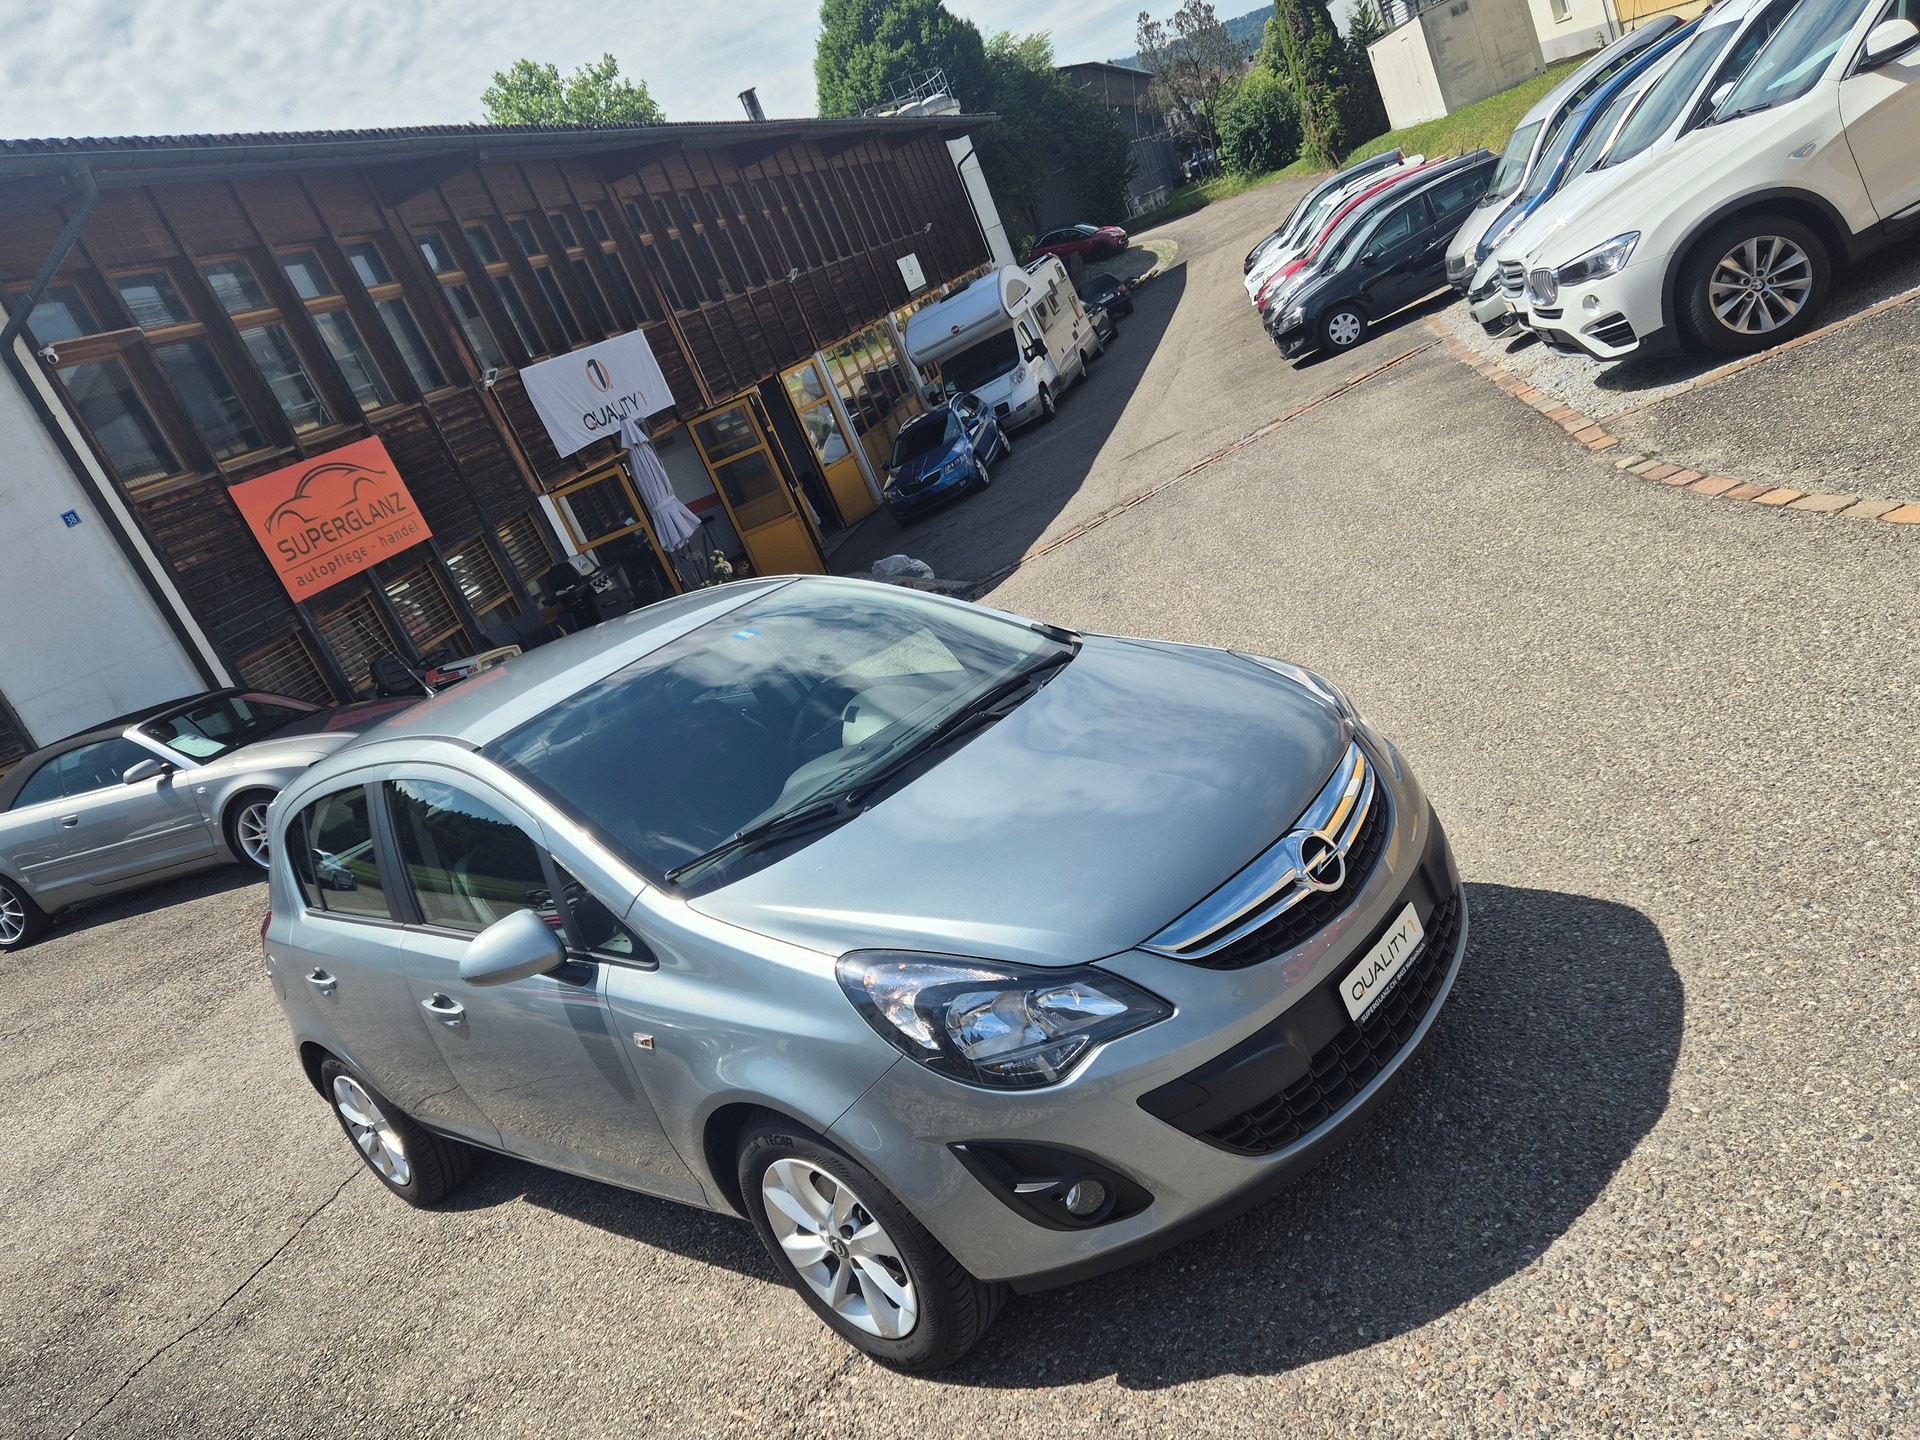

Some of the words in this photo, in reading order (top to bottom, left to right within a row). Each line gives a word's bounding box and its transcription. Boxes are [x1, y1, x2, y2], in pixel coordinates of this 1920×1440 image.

[64, 513, 78, 526] 38
[276, 491, 407, 562] SUPERGLANZ
[295, 546, 369, 587] autopflege
[379, 520, 420, 548] handel
[1361, 978, 1398, 1023] SUPERGLANZ.CH
[762, 1135, 795, 1149] TECAR
